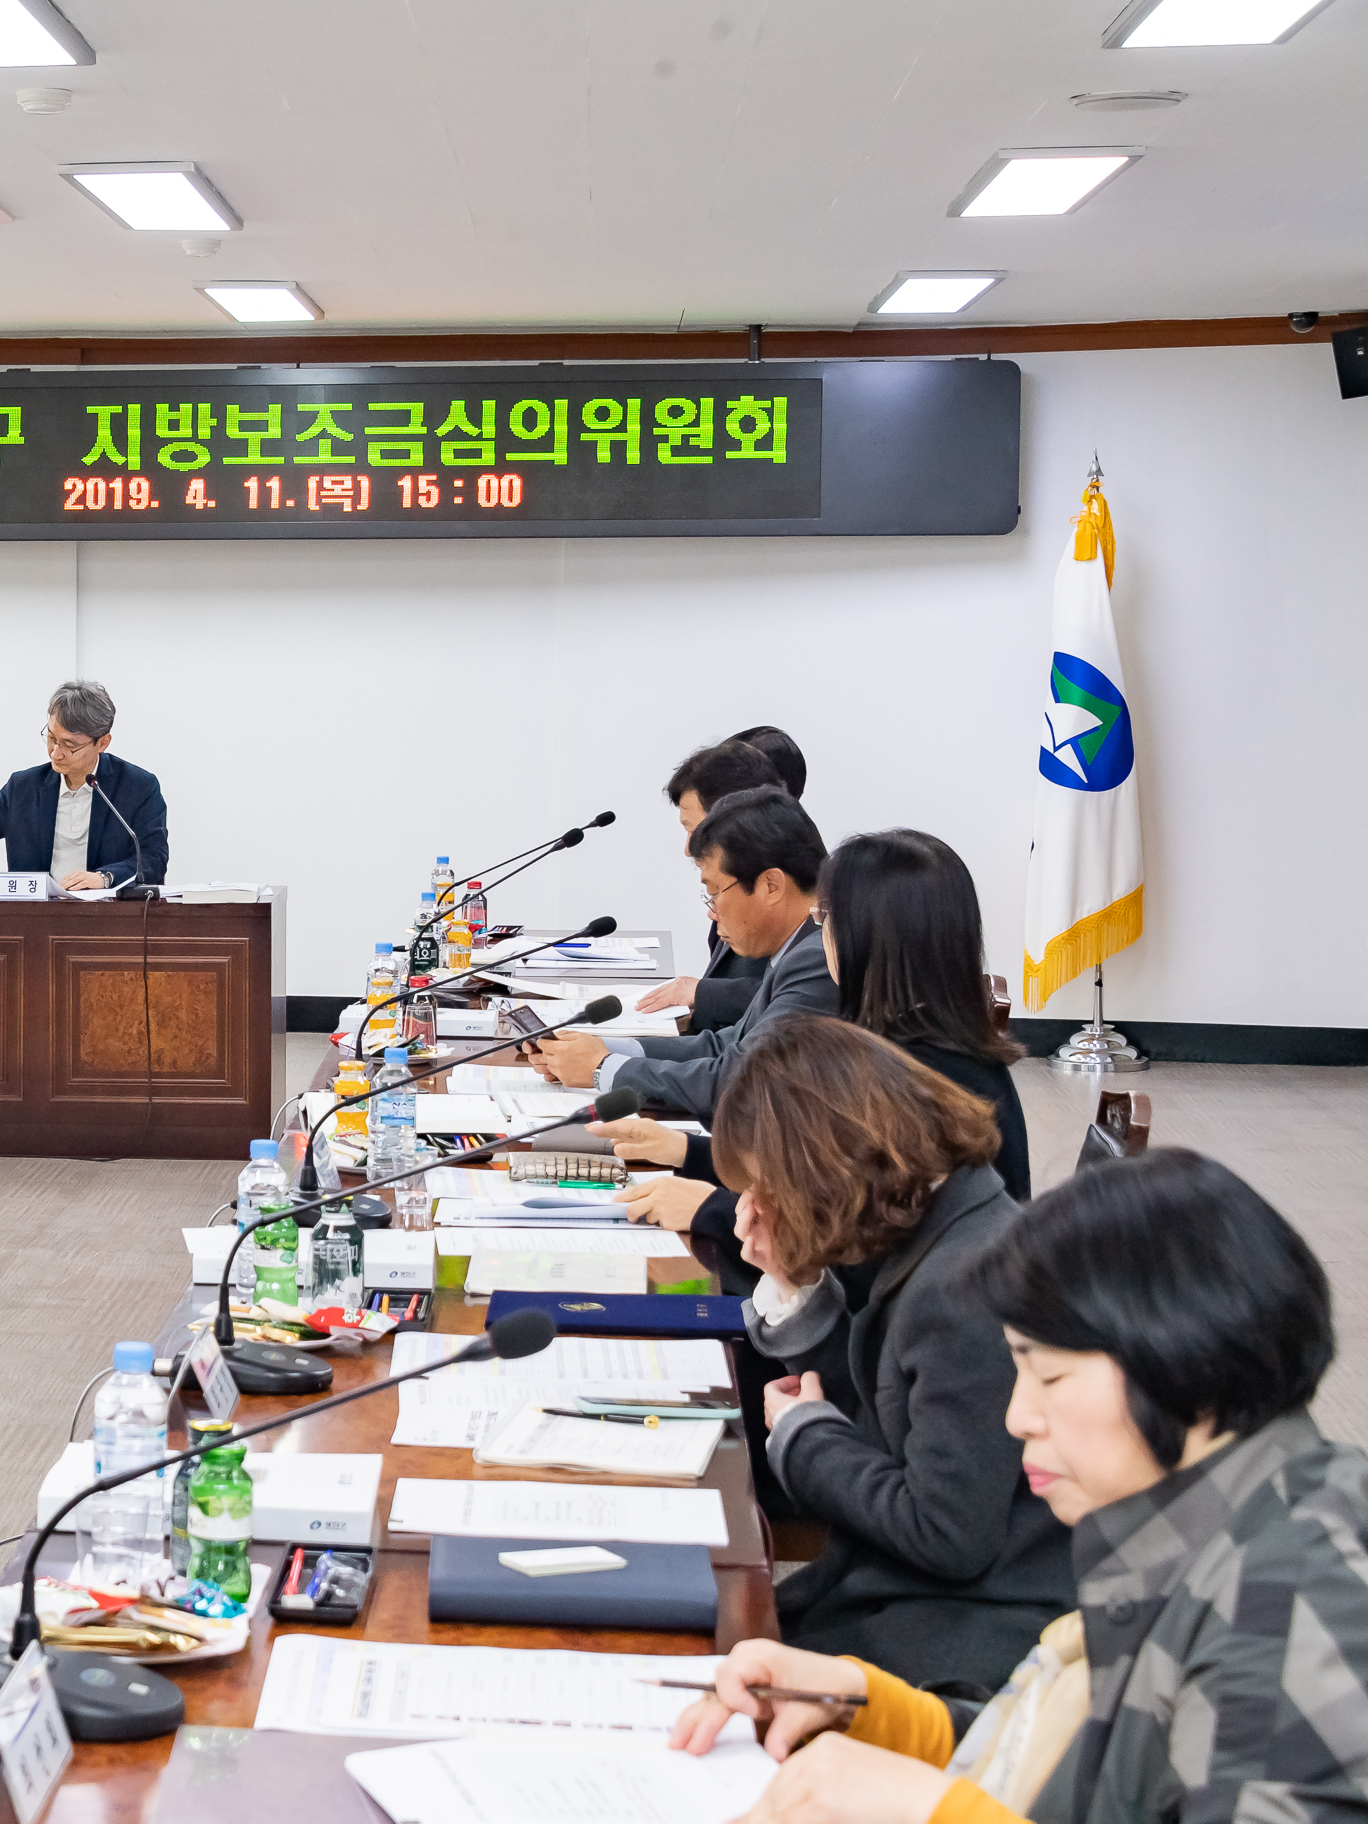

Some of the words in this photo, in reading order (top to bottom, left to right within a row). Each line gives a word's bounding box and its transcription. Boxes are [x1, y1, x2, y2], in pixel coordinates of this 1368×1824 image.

[81, 395, 787, 472] 지방보조금심의위원회
[64, 476, 160, 510] 2019.
[185, 477, 217, 510] 4.
